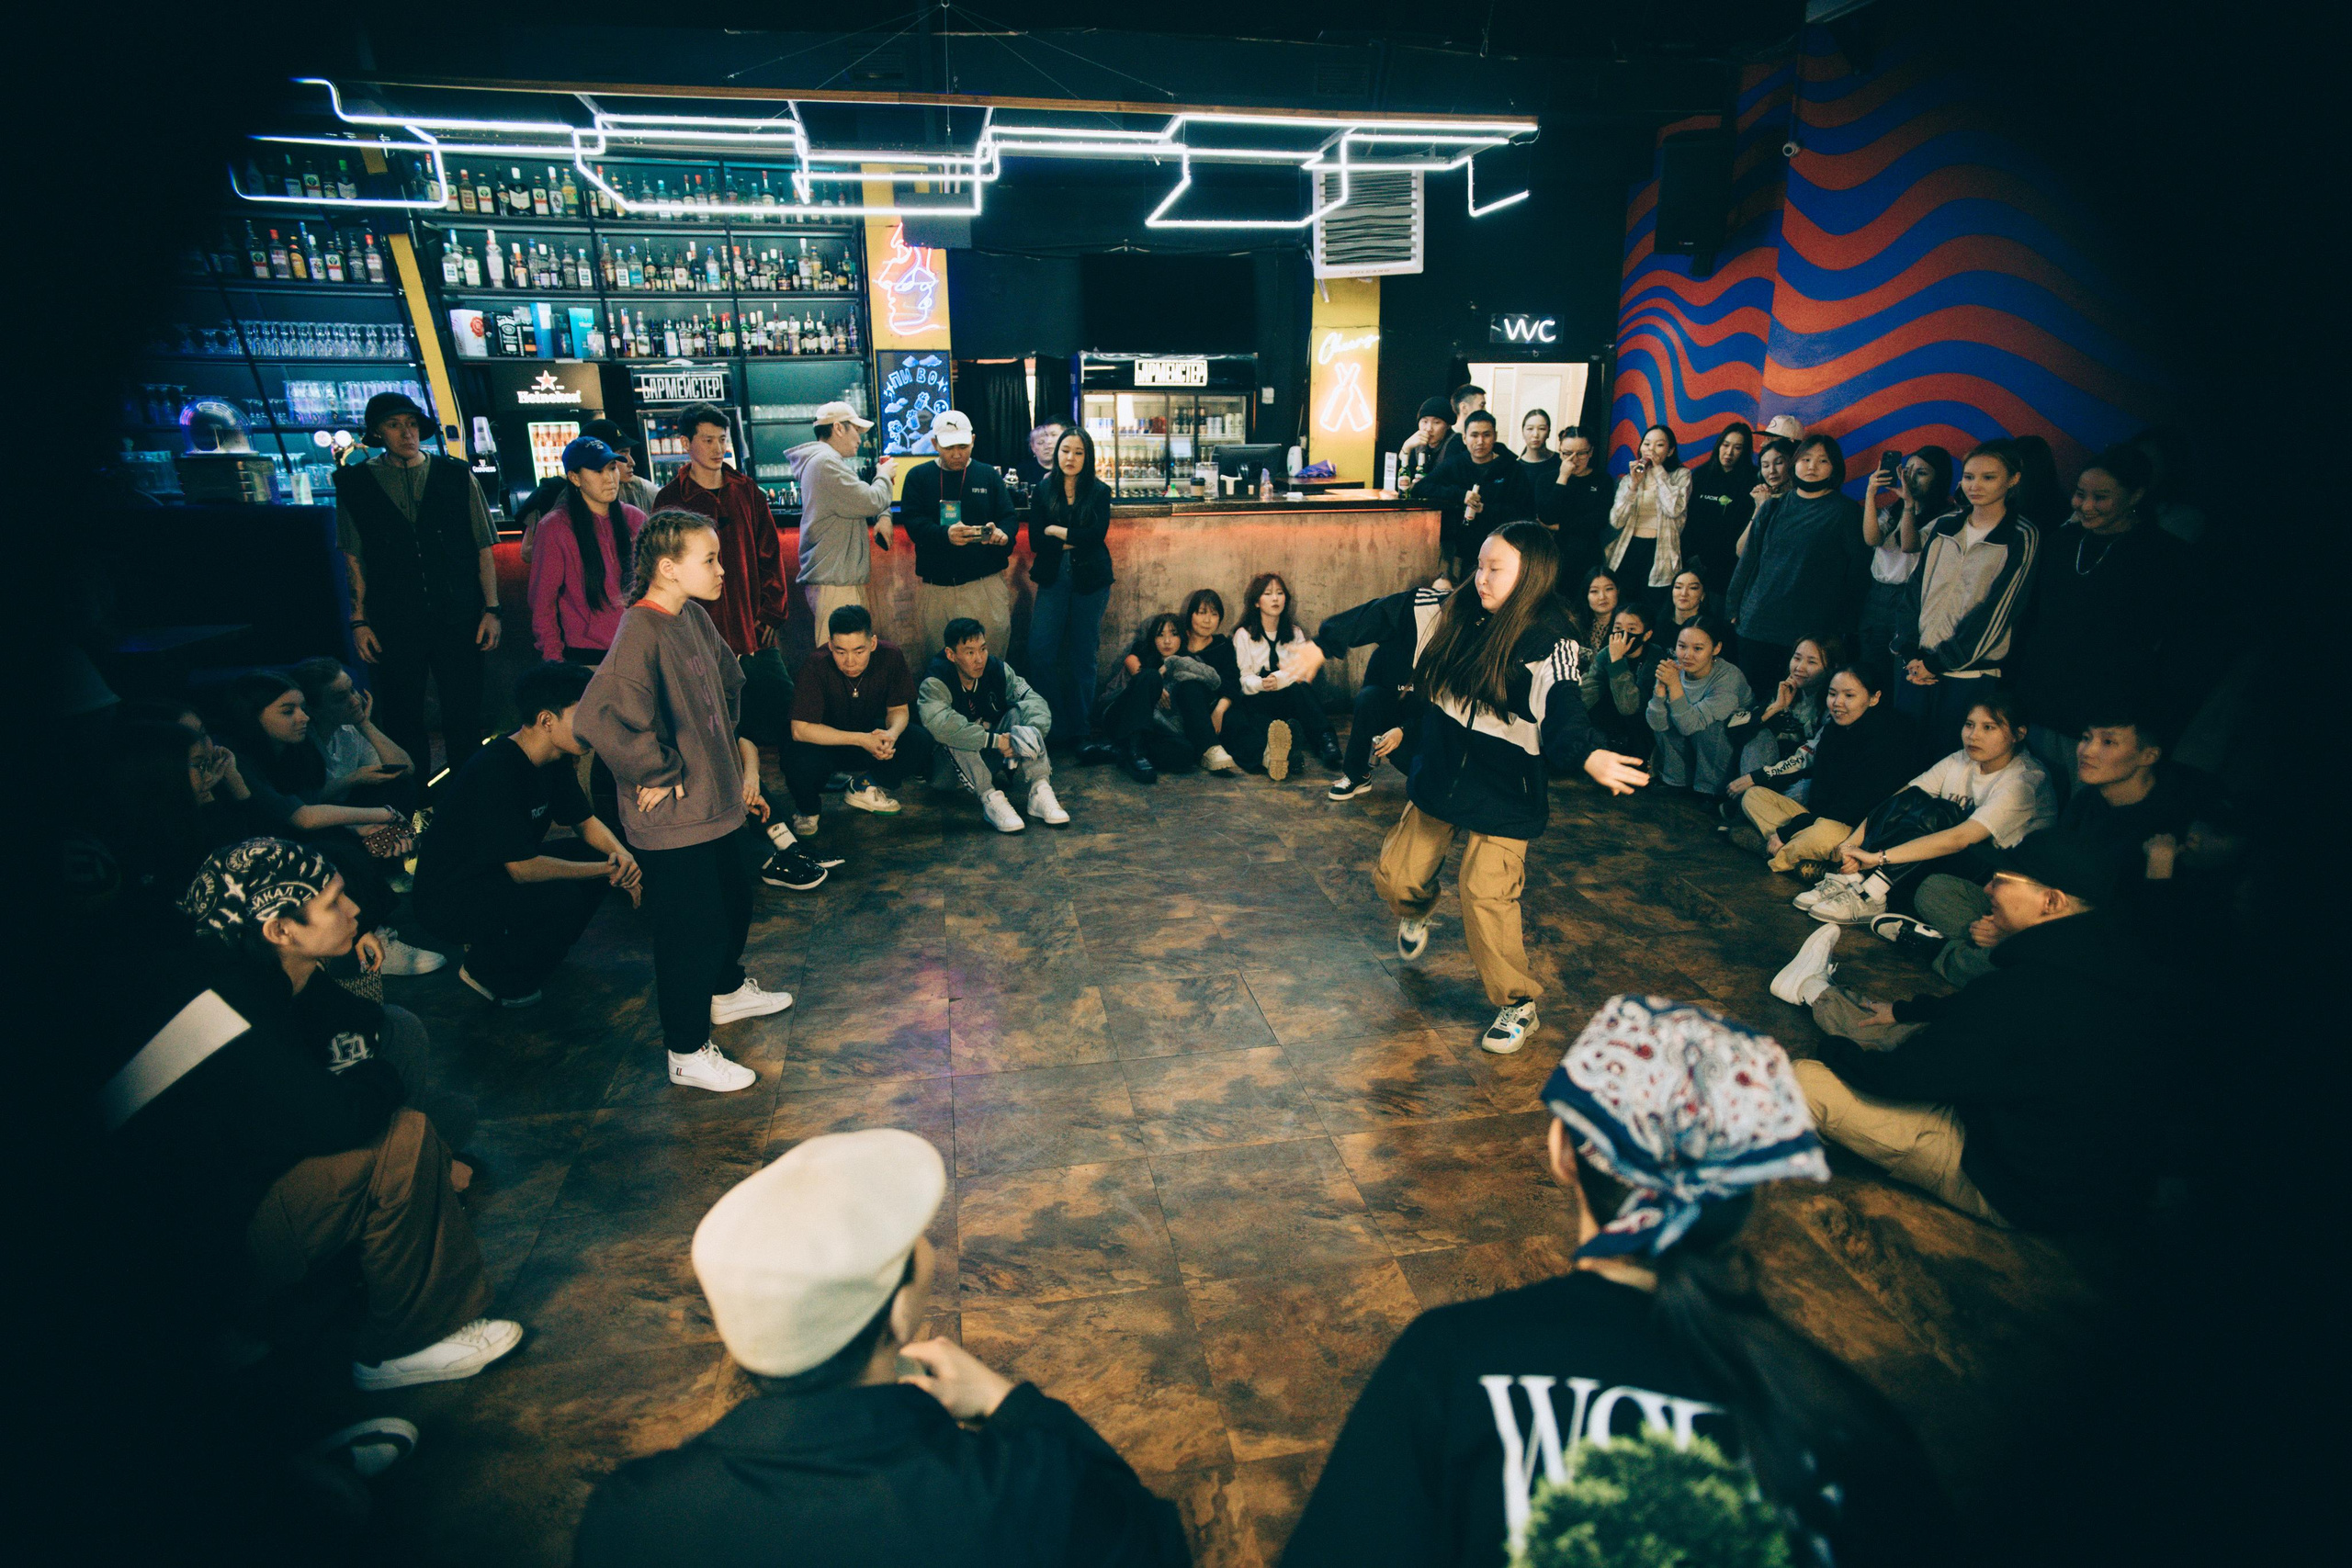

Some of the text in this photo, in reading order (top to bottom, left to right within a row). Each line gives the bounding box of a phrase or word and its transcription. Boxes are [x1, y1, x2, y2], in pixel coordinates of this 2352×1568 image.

[1503, 317, 1556, 343] WC
[516, 390, 582, 404] Heineken
[642, 373, 721, 400] БАРМЕЙСТЕР
